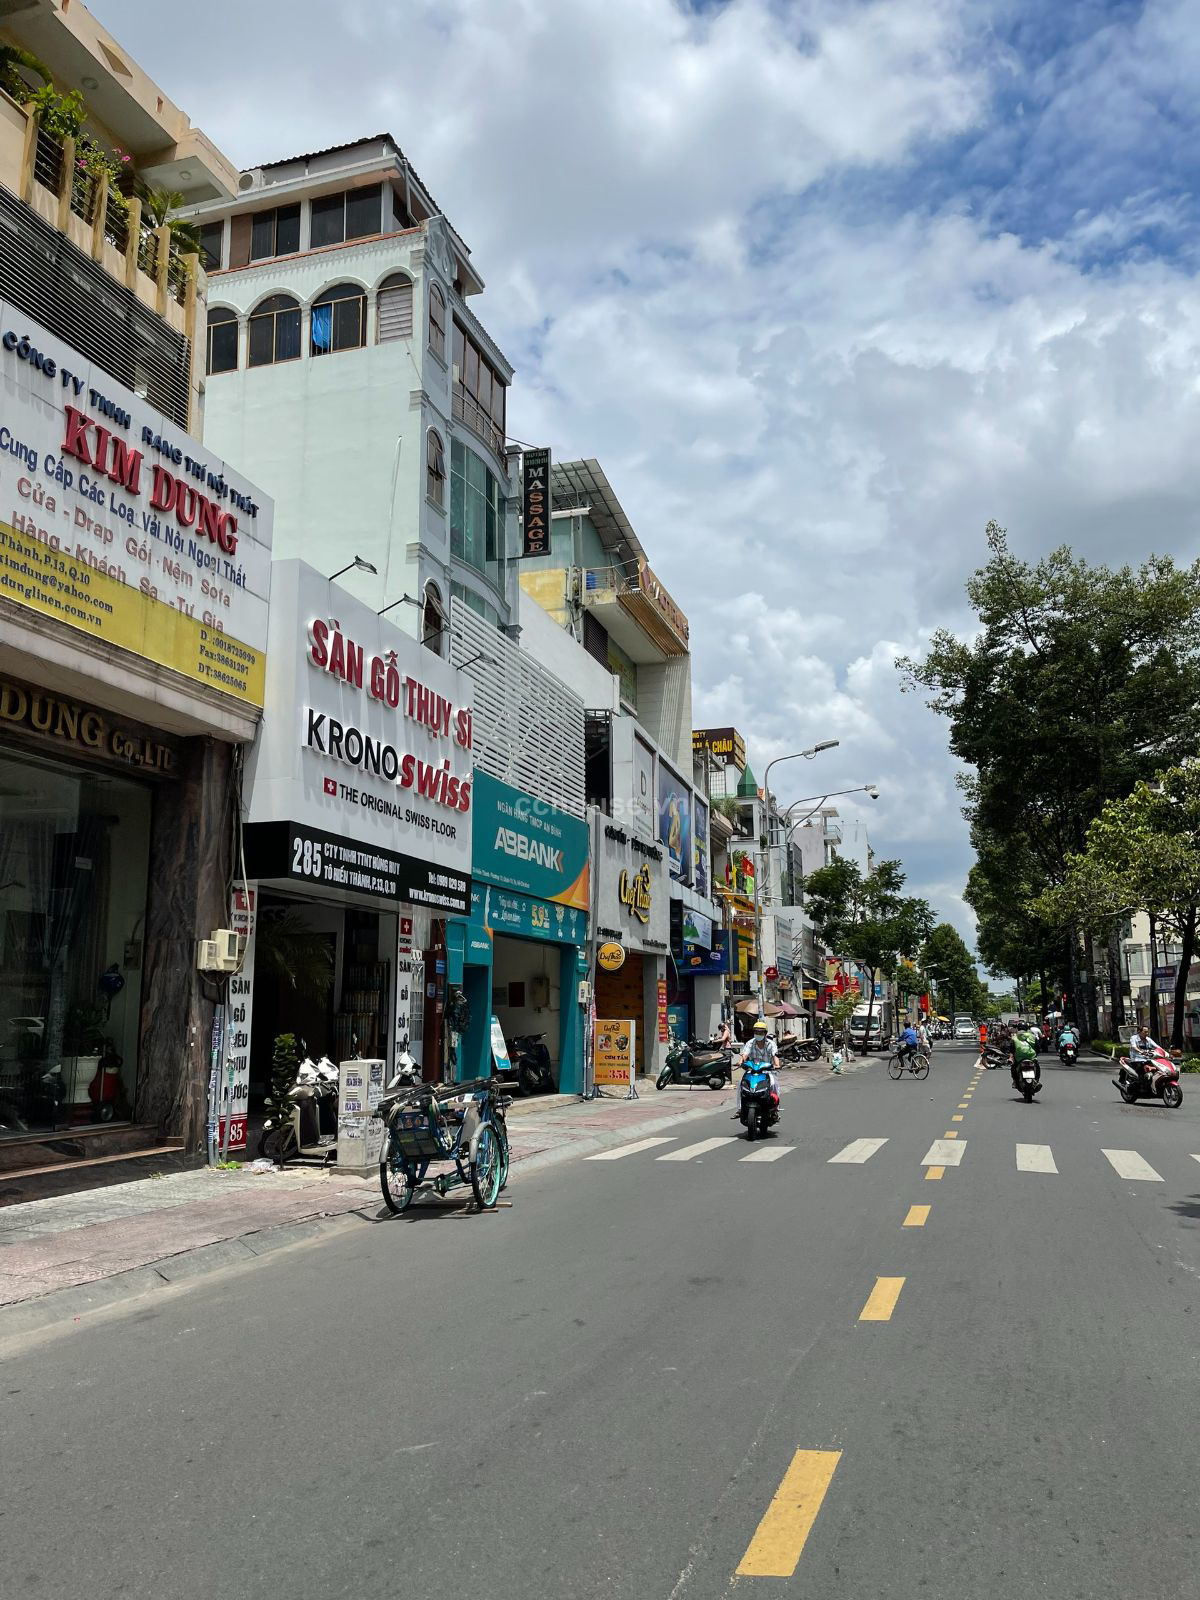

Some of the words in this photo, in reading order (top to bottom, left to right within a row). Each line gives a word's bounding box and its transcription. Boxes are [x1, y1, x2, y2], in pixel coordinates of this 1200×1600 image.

[61, 368, 85, 396] TY
[0, 427, 38, 472] Cung
[44, 454, 73, 490] Cấp
[78, 474, 105, 506] Các
[61, 405, 144, 495] KIM
[150, 464, 239, 555] DUNG
[17, 476, 57, 513] Cửa
[75, 506, 113, 544] Drap
[528, 467, 545, 552] MASSAGE
[12, 511, 61, 553] Hàng
[76, 544, 127, 584] Khách
[308, 618, 365, 690] SÀN
[368, 650, 400, 709] GỖ
[404, 676, 453, 739] THỤY
[0, 683, 104, 749] DUNG
[712, 738, 733, 753] CHÂU
[339, 783, 359, 806] THE
[361, 792, 403, 821] ORIGINAL
[405, 809, 430, 831] SWISS
[431, 816, 457, 840] FLOOR
[292, 837, 322, 878] 285
[324, 842, 338, 860] CTY
[339, 847, 357, 864] TNHH
[324, 863, 333, 880] TÔ
[494, 826, 563, 874] ABBANK
[231, 974, 250, 995] SÀN
[233, 1001, 246, 1022] GỖ
[232, 1027, 248, 1047] IÊU
[229, 1121, 243, 1143] 85
